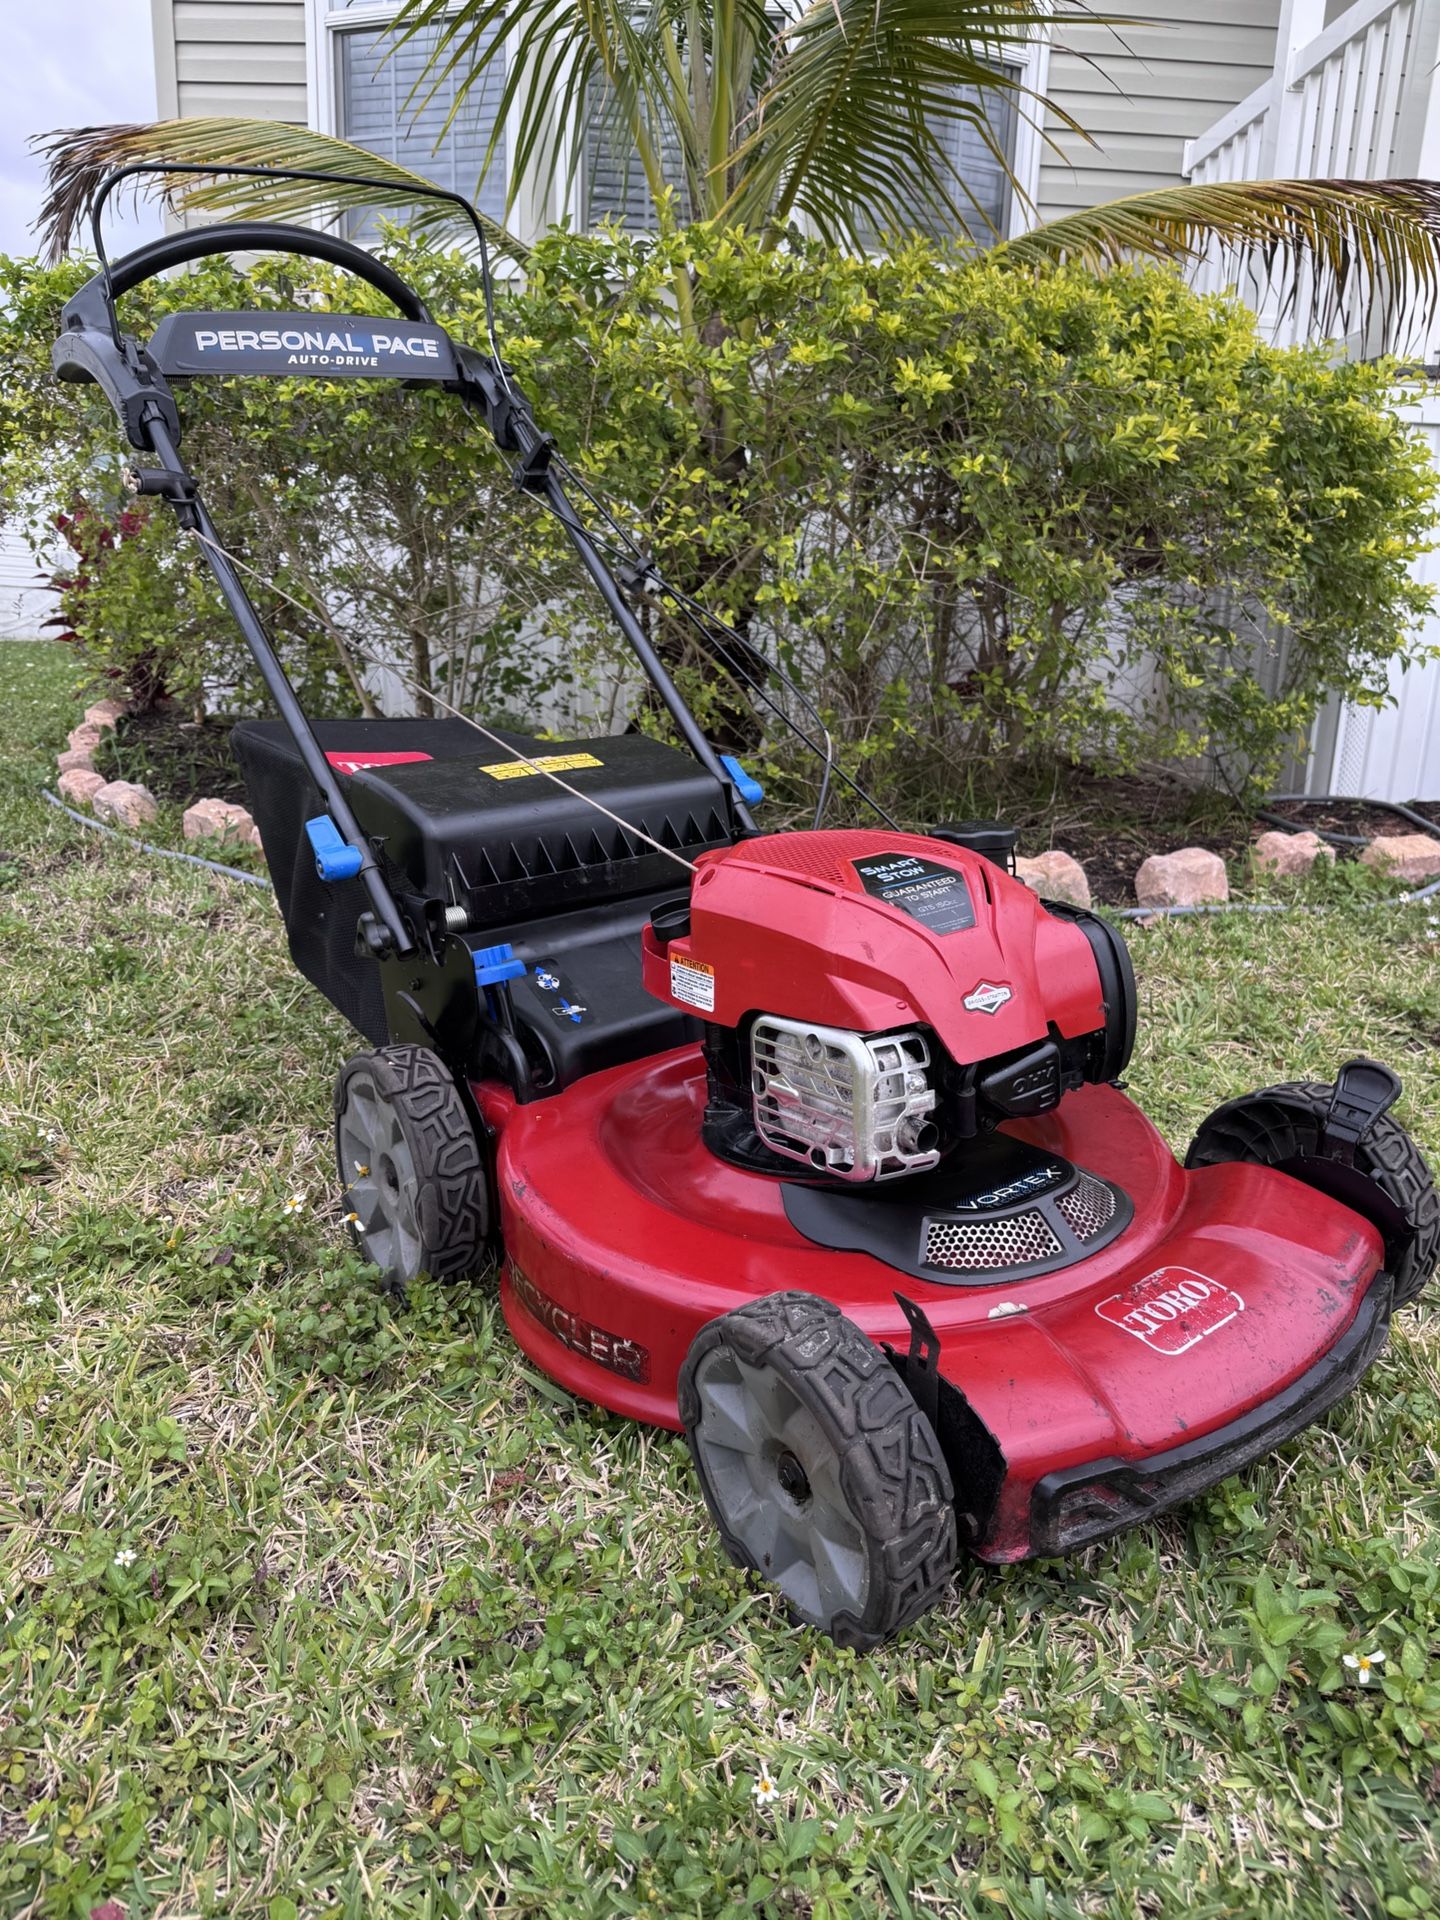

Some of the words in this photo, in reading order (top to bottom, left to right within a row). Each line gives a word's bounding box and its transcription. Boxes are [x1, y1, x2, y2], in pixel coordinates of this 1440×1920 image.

[194, 330, 365, 353] PERSONAL
[371, 334, 440, 358] PACE
[287, 353, 380, 367] AUTO-DRIVE
[860, 857, 920, 876] SMART
[876, 865, 926, 882] STOW
[882, 876, 957, 899] GUARANTEED
[904, 894, 920, 902] TO
[920, 886, 952, 898] START
[680, 957, 710, 974] ATTENTION
[956, 1168, 1062, 1209] VORTEX
[1123, 1280, 1211, 1335] TORO
